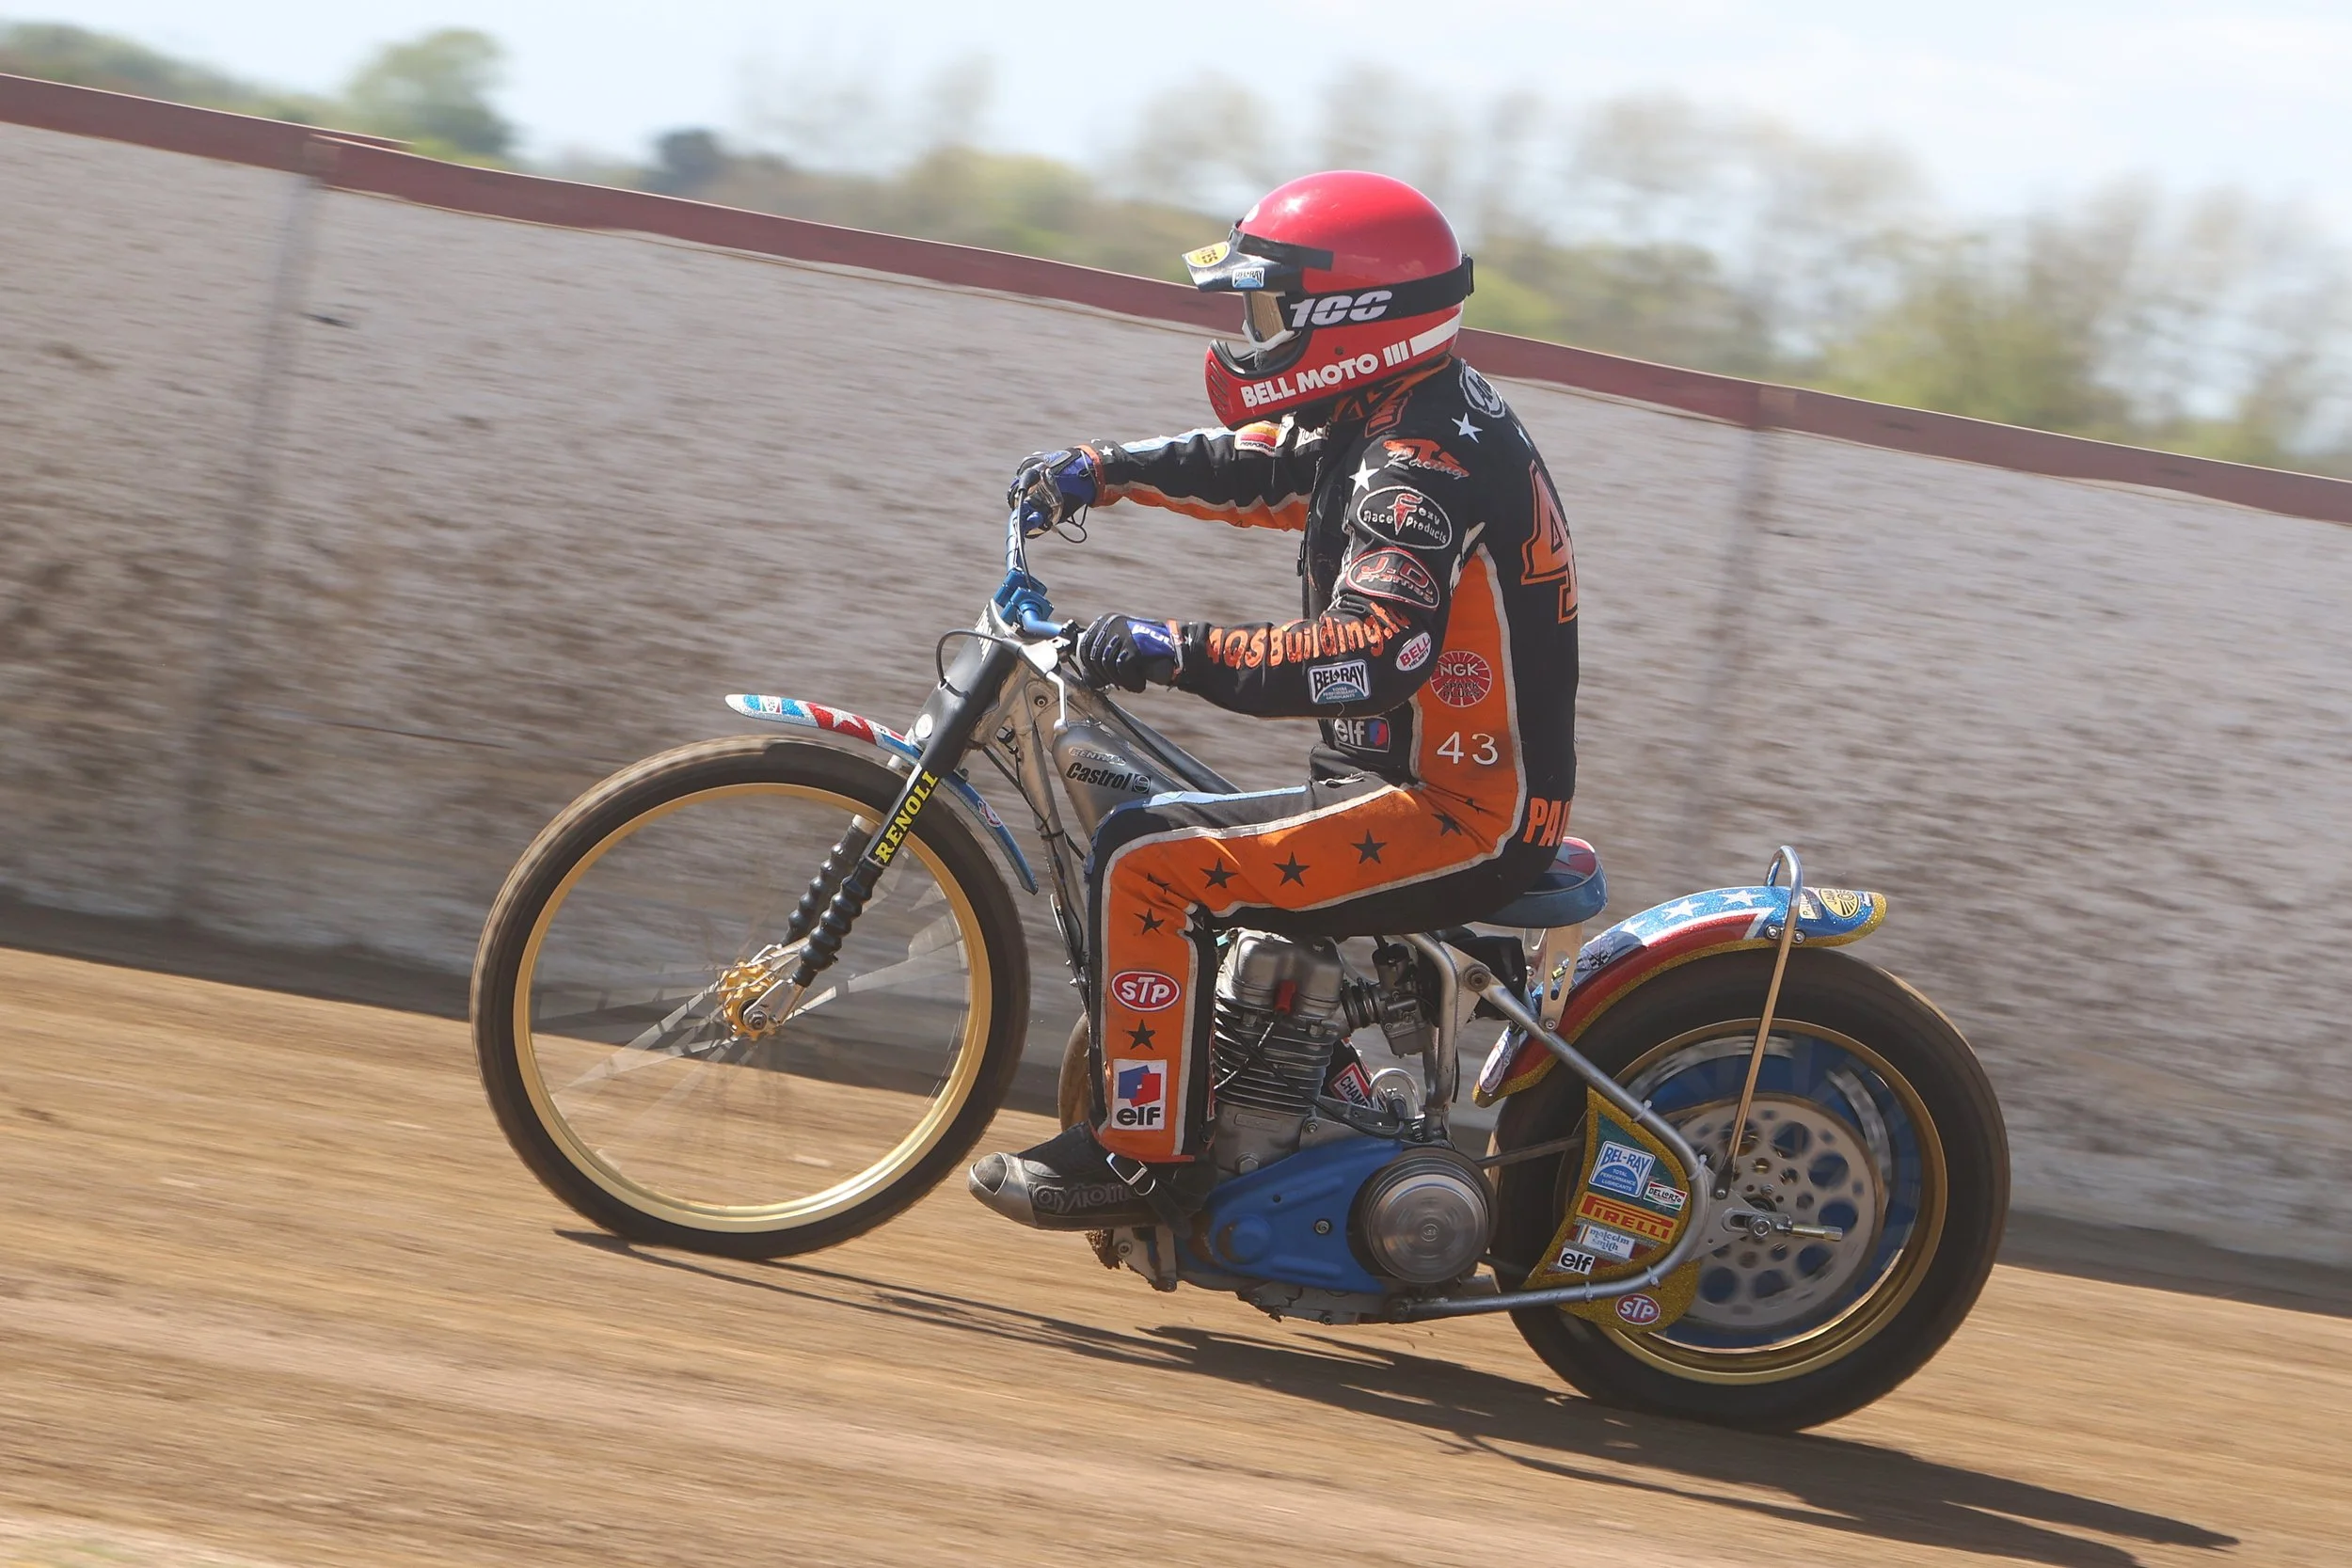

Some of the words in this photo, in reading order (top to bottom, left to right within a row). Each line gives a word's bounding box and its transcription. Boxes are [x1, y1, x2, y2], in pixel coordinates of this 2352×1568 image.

[1240, 377, 1296, 408] BELL
[1295, 353, 1379, 394] MOTO
[1382, 340, 1410, 368] III
[1406, 515, 1447, 545] Products
[1400, 637, 1430, 667] BELL
[1439, 663, 1479, 676] NGK
[1442, 689, 1480, 698] PLUGS
[1334, 718, 1365, 746] elf
[1066, 762, 1131, 791] Castrol
[1120, 976, 1169, 1004] STP
[1117, 1106, 1160, 1126] elf
[1601, 1147, 1650, 1179] BEL-RAY
[1600, 1172, 1637, 1185] PERFORMANCE
[1601, 1180, 1632, 1192] LUBRICANTS
[1581, 1195, 1674, 1240] PIRELLI
[1560, 1252, 1593, 1272] elf
[1620, 1297, 1655, 1319] STP
